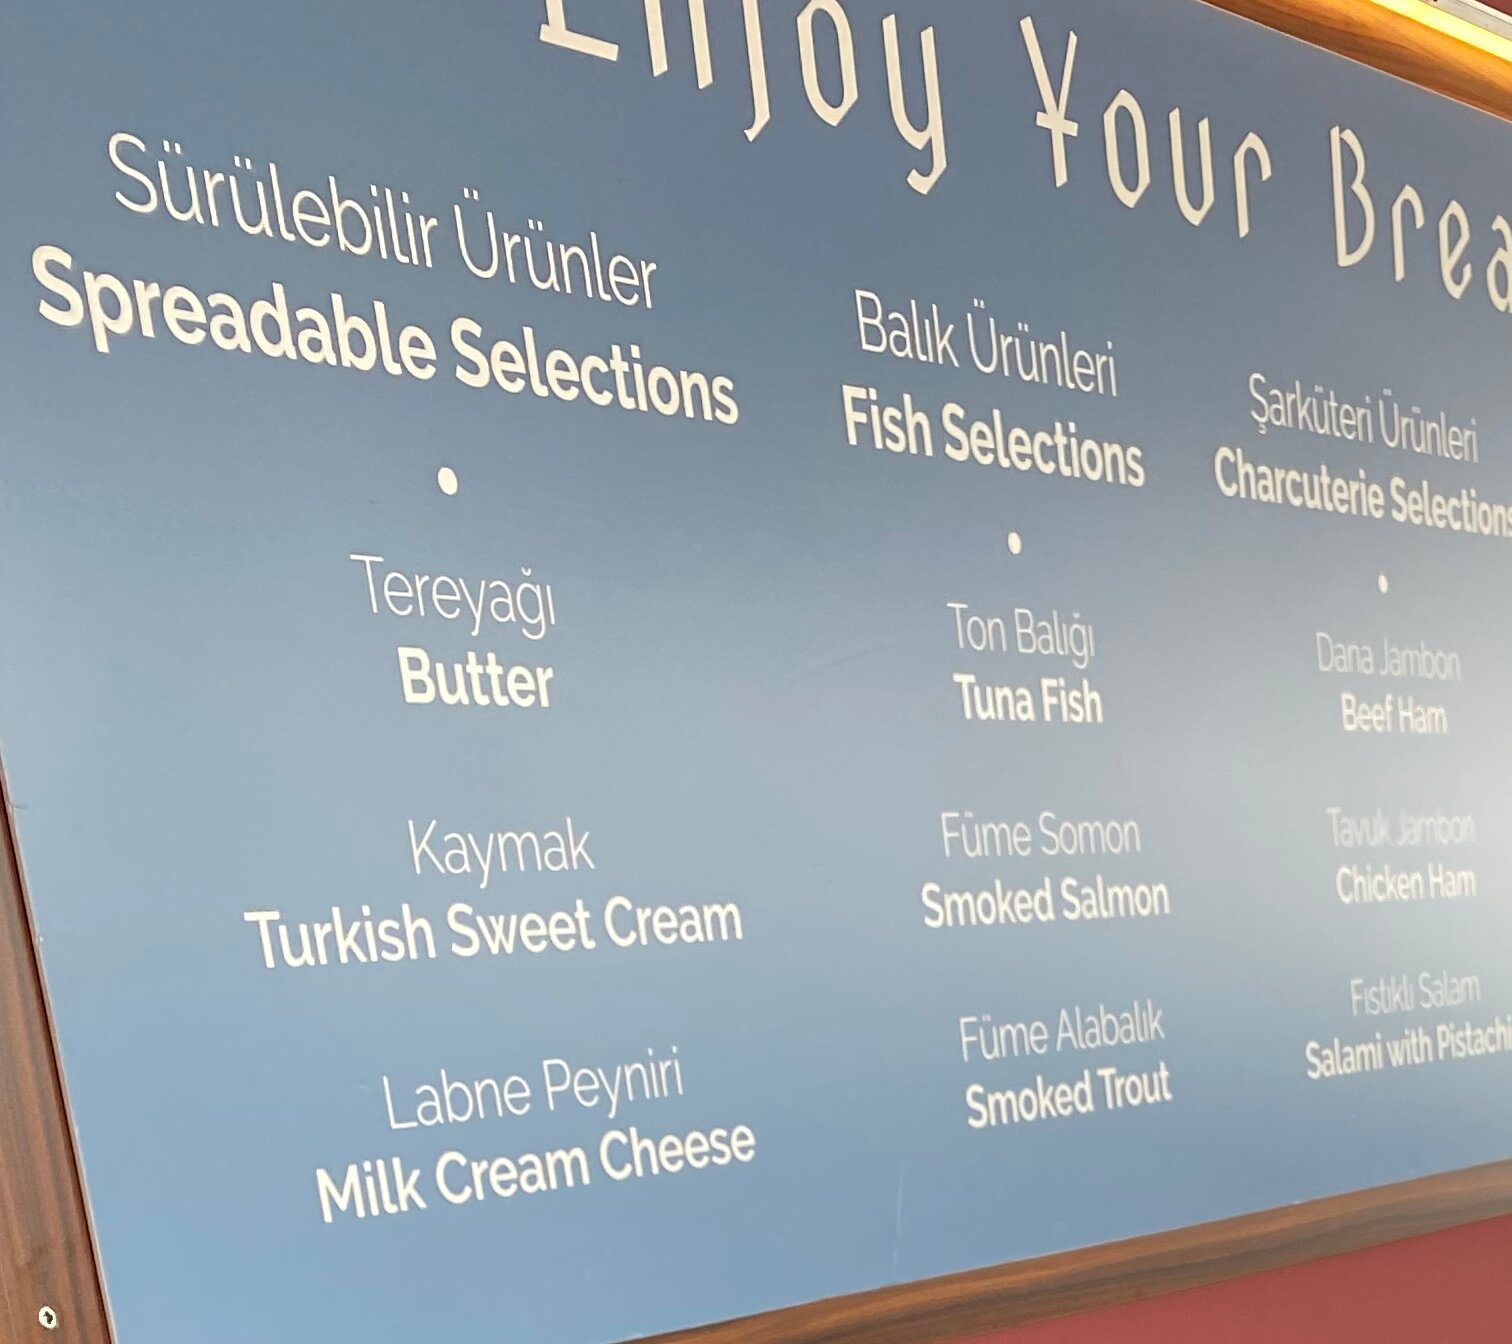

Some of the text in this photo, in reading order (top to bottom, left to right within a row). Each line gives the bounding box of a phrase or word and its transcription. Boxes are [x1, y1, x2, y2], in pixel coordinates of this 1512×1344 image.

[1020, 16, 1272, 238] Your
[108, 132, 656, 308] Sürülebilir Ürünler
[32, 245, 738, 425] Spreadable Selections
[855, 289, 1117, 396] Balık Ürünleri
[842, 384, 1145, 487] Fish Selections
[1249, 373, 1479, 463] Şarküteri Ürünleri
[1214, 447, 1384, 519] Charcuterie
[351, 554, 556, 638] Tereyağı
[947, 603, 1095, 669] Ton Balığı
[1316, 632, 1461, 680] Dana Jambon
[398, 645, 554, 708] Butter
[953, 673, 1103, 723] Tuna Fish
[1341, 692, 1448, 734] Beef Ham
[408, 818, 595, 888] Kaymak
[941, 811, 1141, 858] Füme Somon
[1326, 806, 1477, 847] Tavuk Jambon
[922, 874, 1170, 928] Smoked Salmon
[1336, 863, 1477, 904] Chicken Ham
[244, 894, 742, 968] Turkish Sweet Cream
[1418, 969, 1481, 1008] Salam
[959, 998, 1165, 1062] Füme Alabalık
[1305, 1033, 1384, 1080] Salami
[1387, 1027, 1433, 1067] with
[382, 1045, 684, 1131] Labne Peyniri
[966, 1061, 1172, 1129] Smoked Trout
[316, 1122, 756, 1224] Milk Cream Cheese
